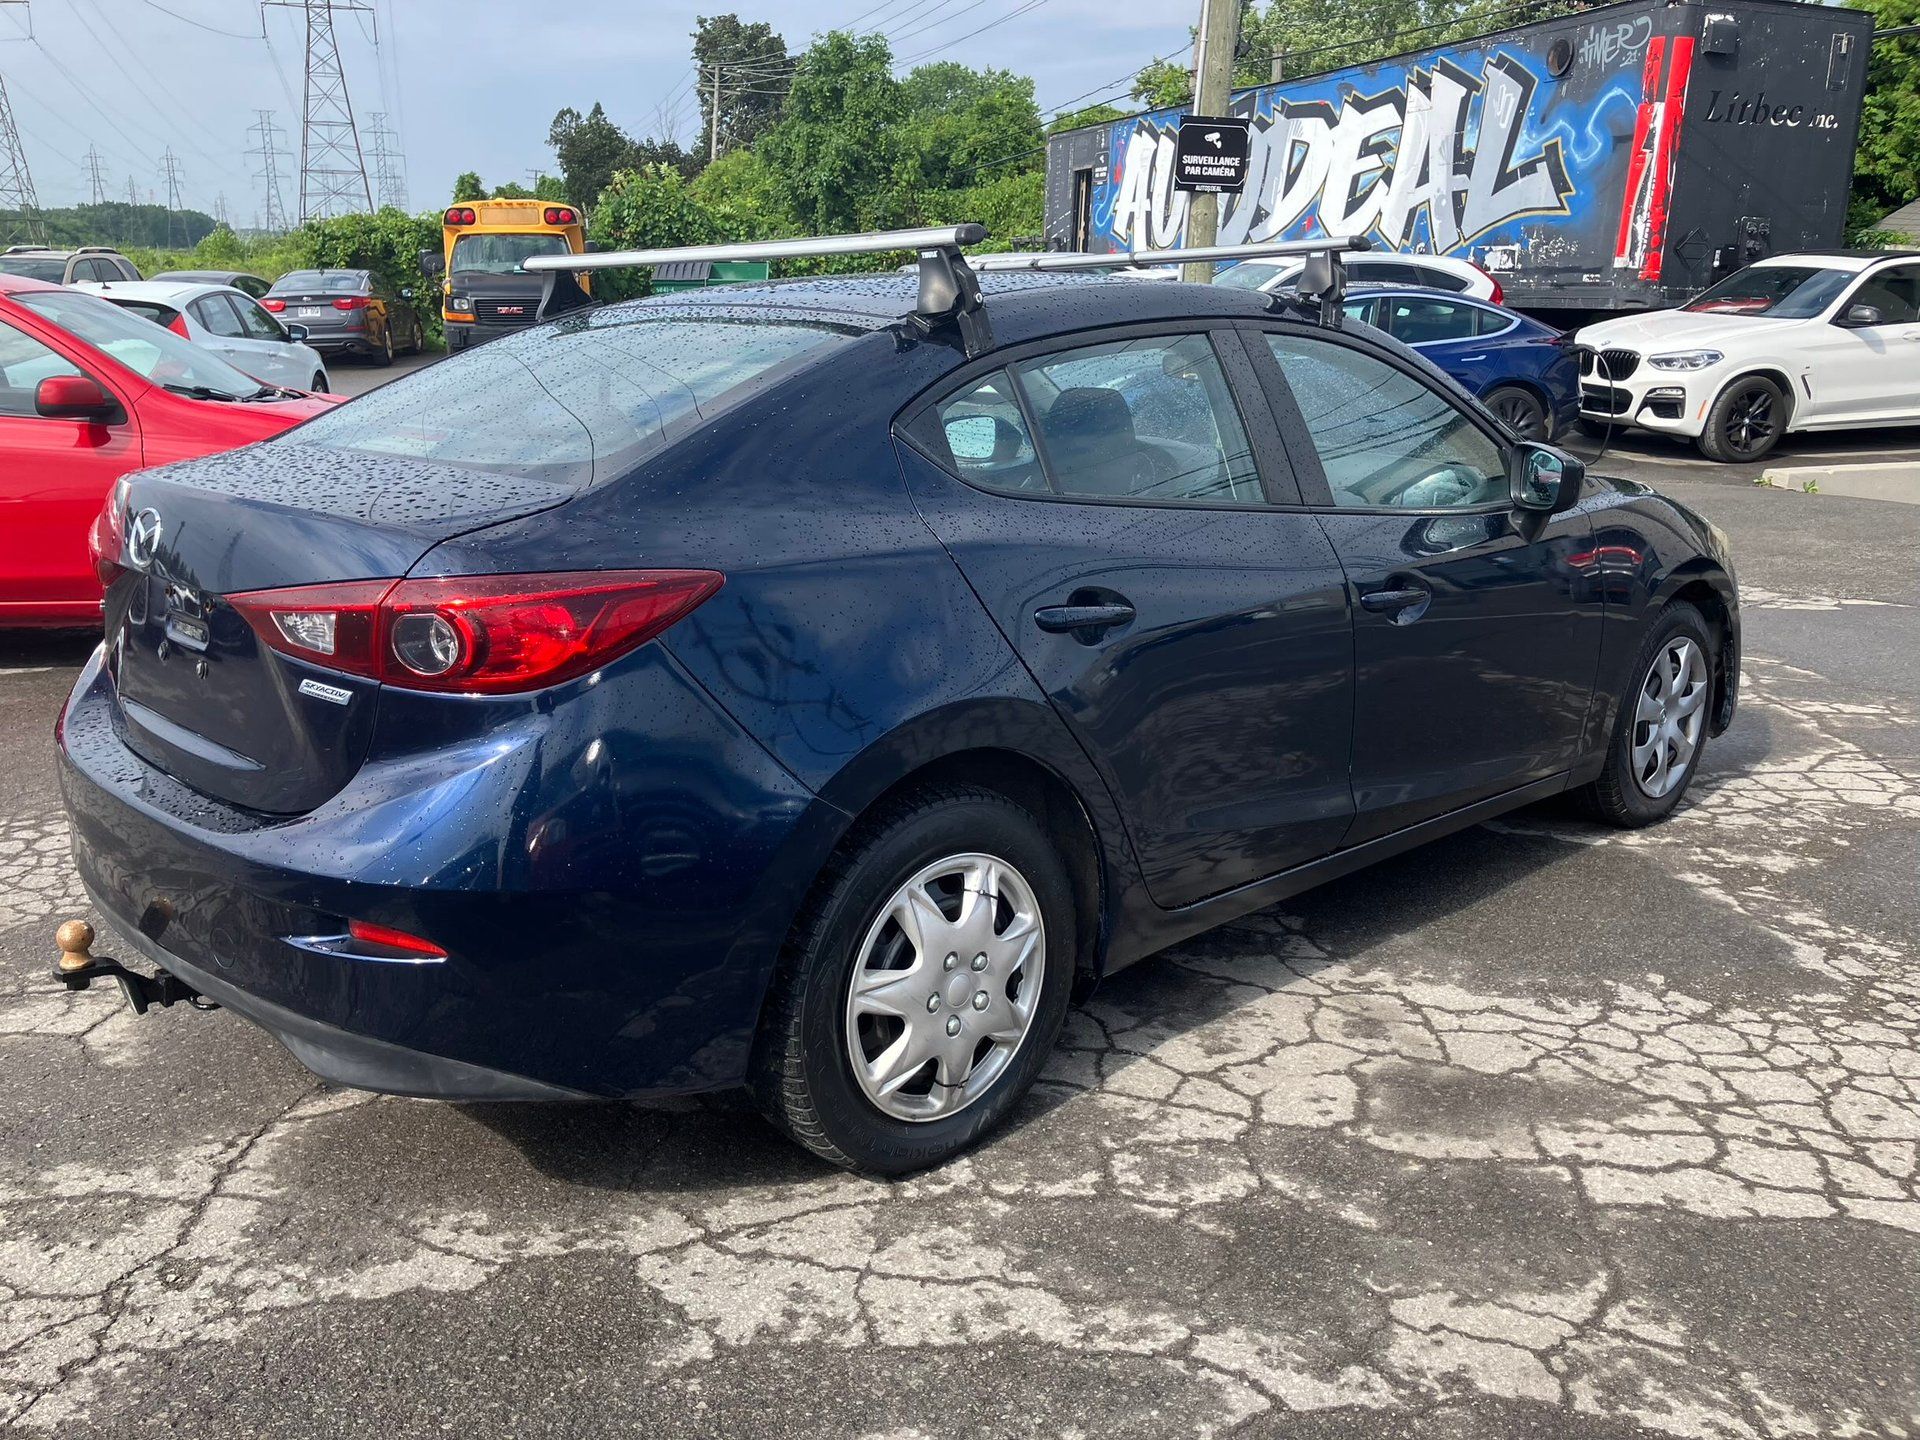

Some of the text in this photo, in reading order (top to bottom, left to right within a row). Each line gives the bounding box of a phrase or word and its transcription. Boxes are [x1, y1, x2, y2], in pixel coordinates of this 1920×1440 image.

[1705, 90, 1804, 127] Litbec
[1182, 155, 1240, 166] SURVEILLANCE
[1185, 166, 1235, 177] PAR CAMÉRA
